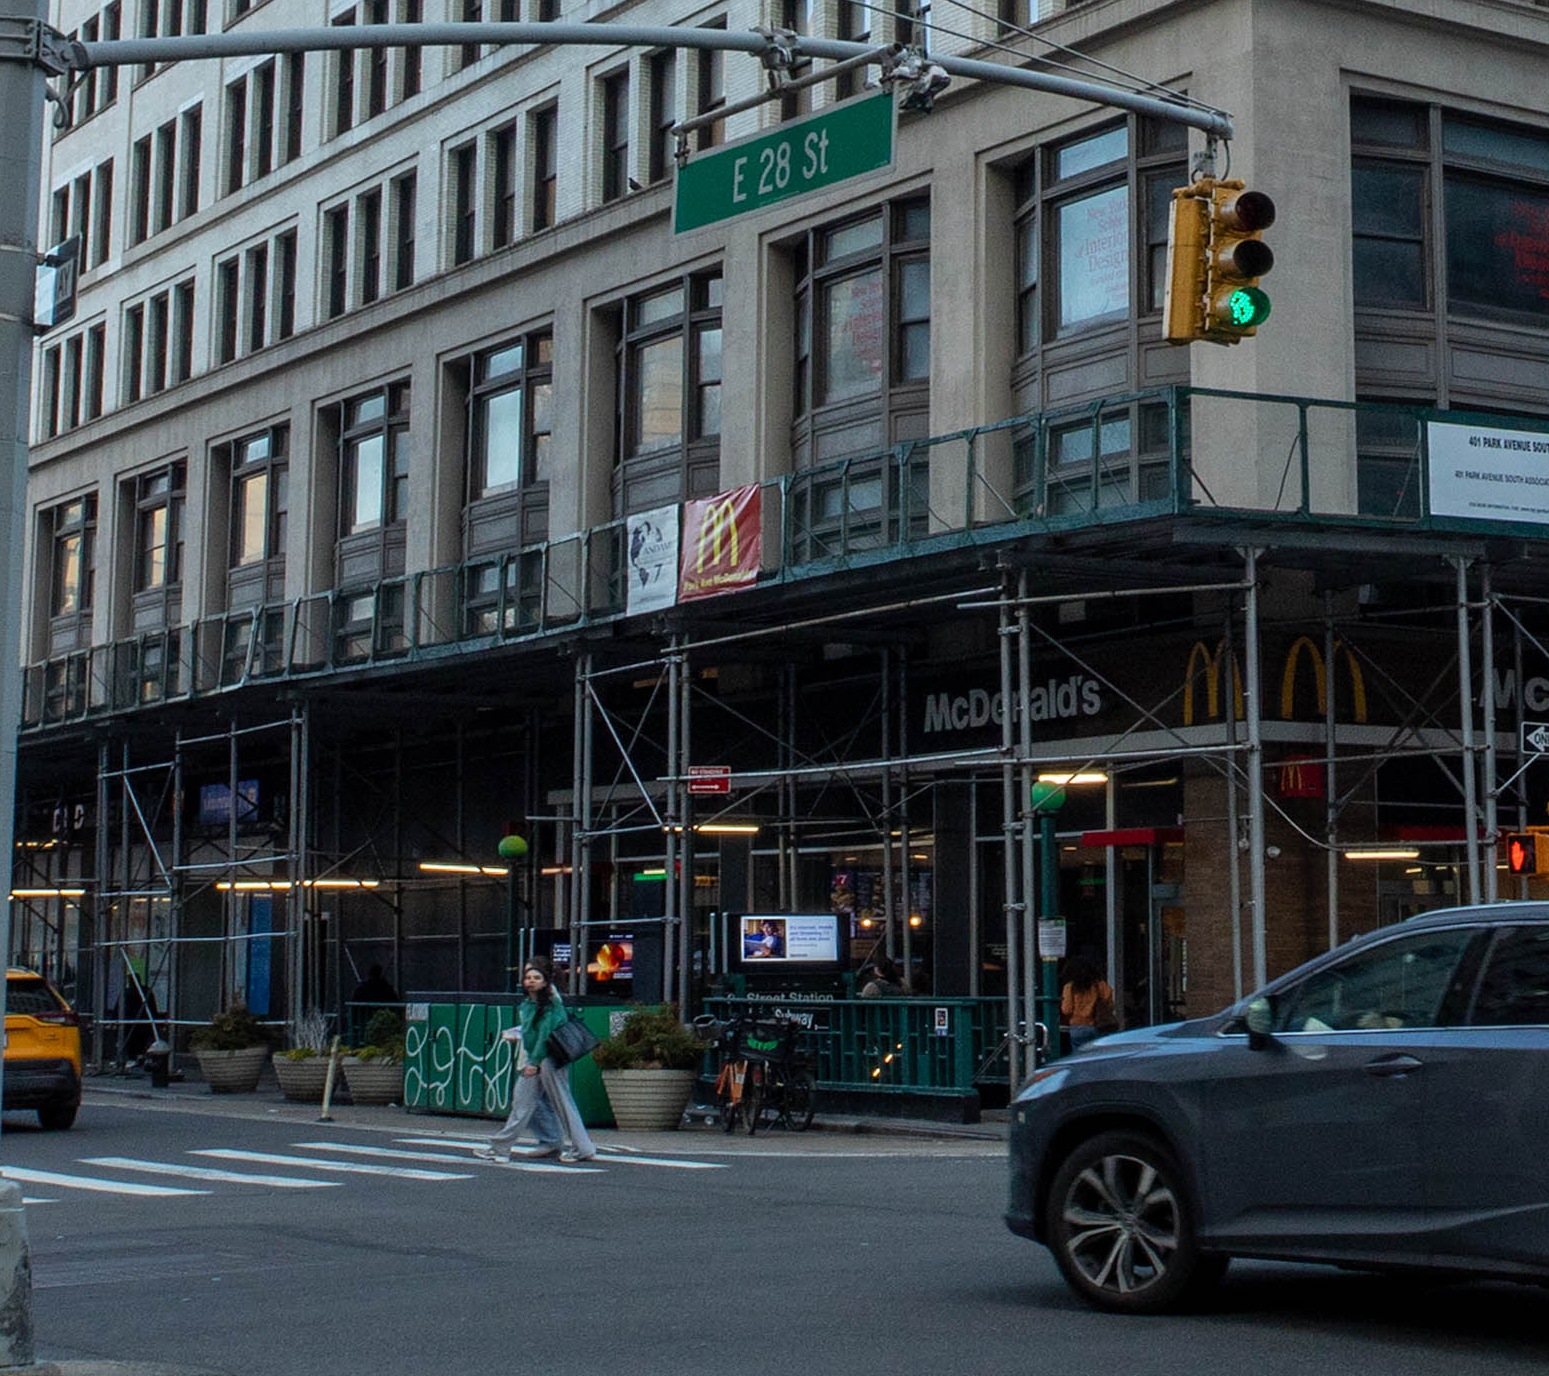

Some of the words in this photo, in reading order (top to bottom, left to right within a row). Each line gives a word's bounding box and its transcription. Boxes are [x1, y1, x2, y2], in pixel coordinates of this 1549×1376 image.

[733, 156, 748, 203] E
[758, 141, 791, 195] 28
[802, 128, 829, 179] St
[1469, 435, 1481, 447] 401
[1483, 437, 1502, 449] PARK
[1504, 439, 1531, 452] AVENUE
[1465, 471, 1480, 480] PARK
[1482, 472, 1504, 483] AVENUE
[1505, 474, 1523, 484] SOUTH
